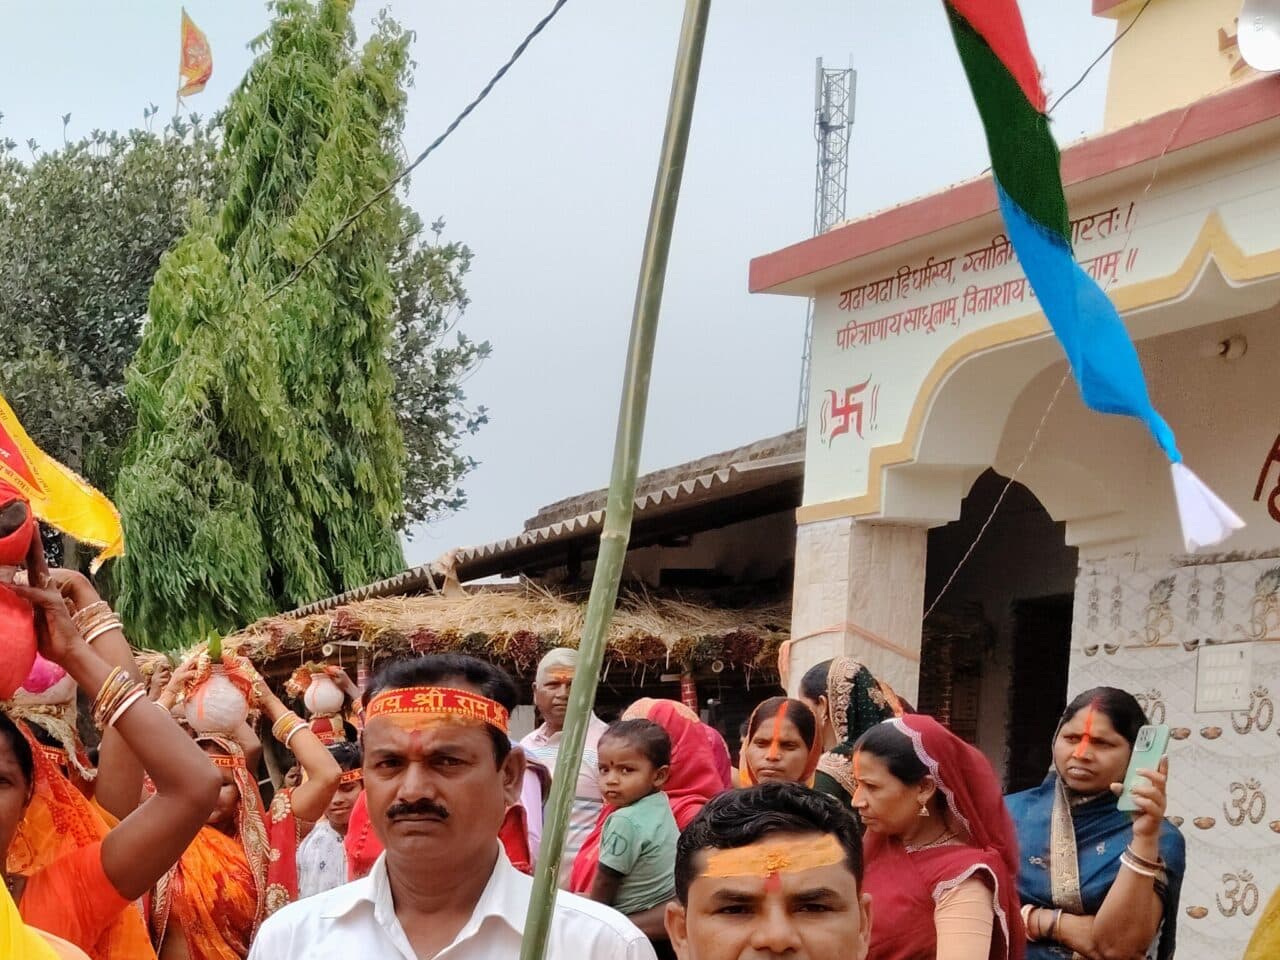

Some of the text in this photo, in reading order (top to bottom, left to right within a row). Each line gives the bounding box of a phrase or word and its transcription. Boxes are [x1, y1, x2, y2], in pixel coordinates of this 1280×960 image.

[372, 690, 489, 717] जय श्री राम
